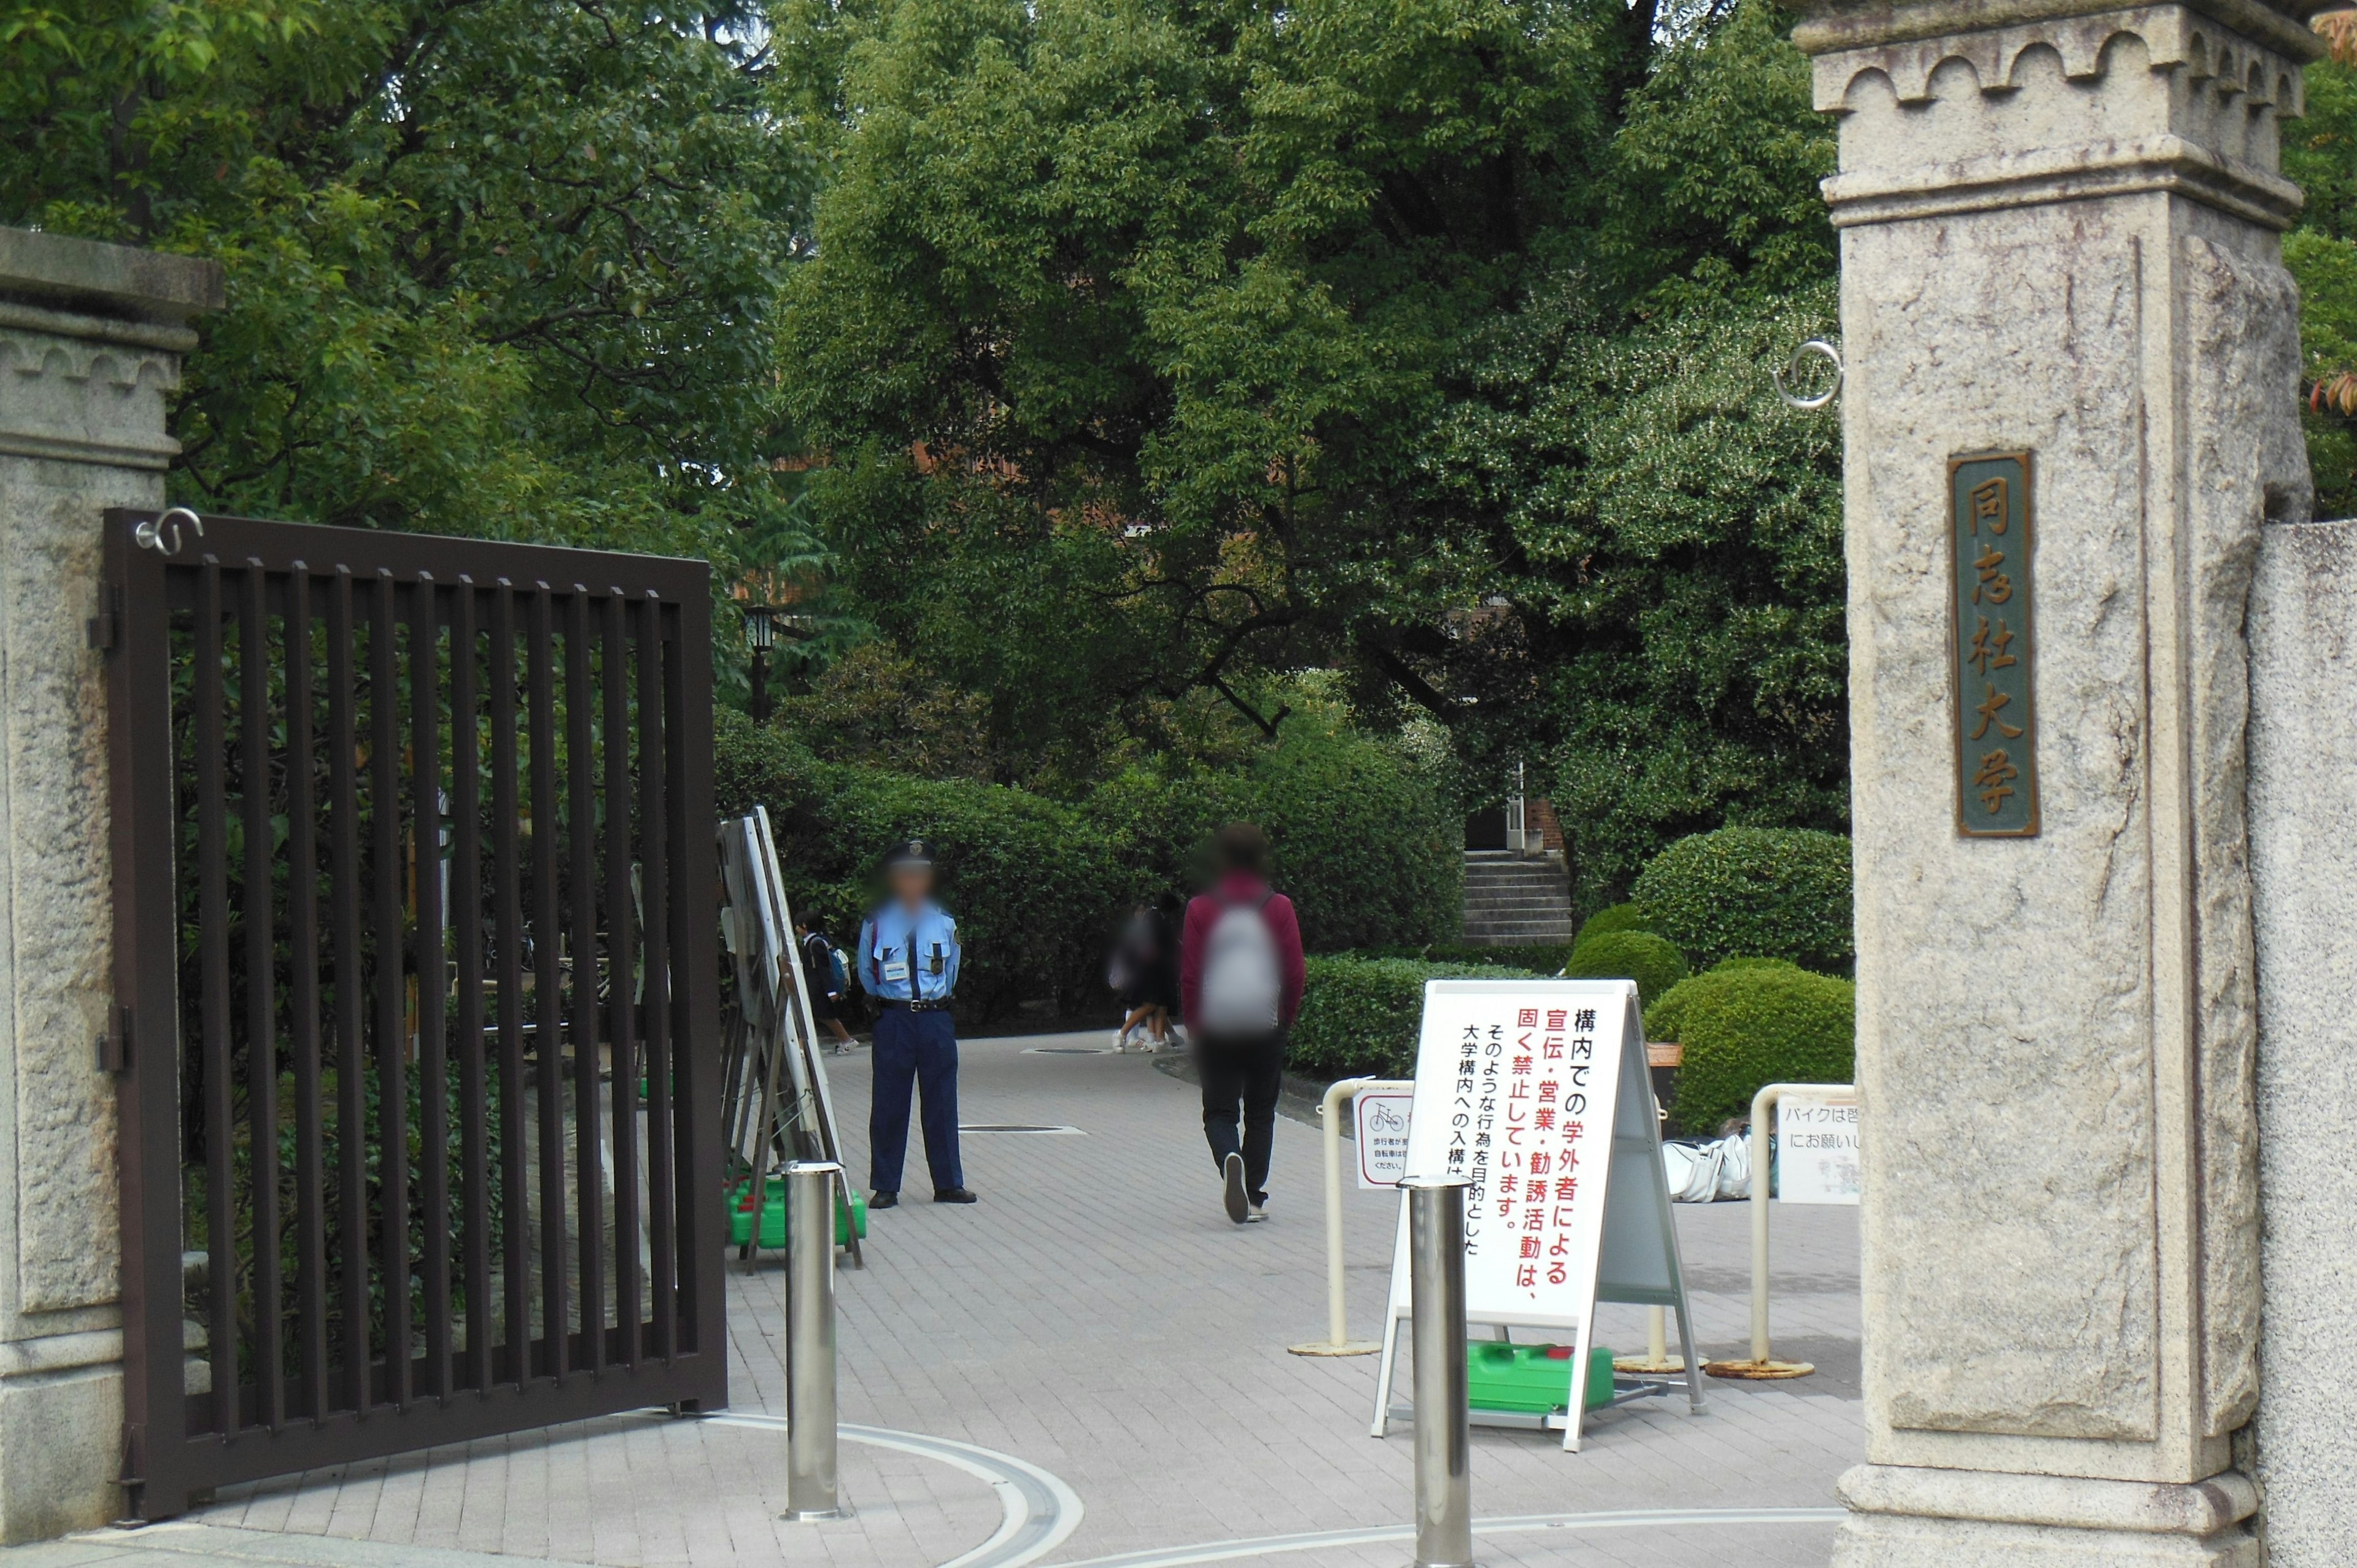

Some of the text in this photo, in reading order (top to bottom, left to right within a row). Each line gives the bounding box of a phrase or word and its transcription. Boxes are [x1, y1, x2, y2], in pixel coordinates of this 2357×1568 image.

[1967, 476, 2024, 815] 同志社大学
[1465, 1024, 1504, 1255] そのような行為を目的とした
[1496, 1008, 1539, 1229] 固く禁止しています。
[1515, 1009, 1568, 1299] 宣伝・営業・勧誘活動は、
[1546, 1008, 1596, 1285] 構内での学外者による
